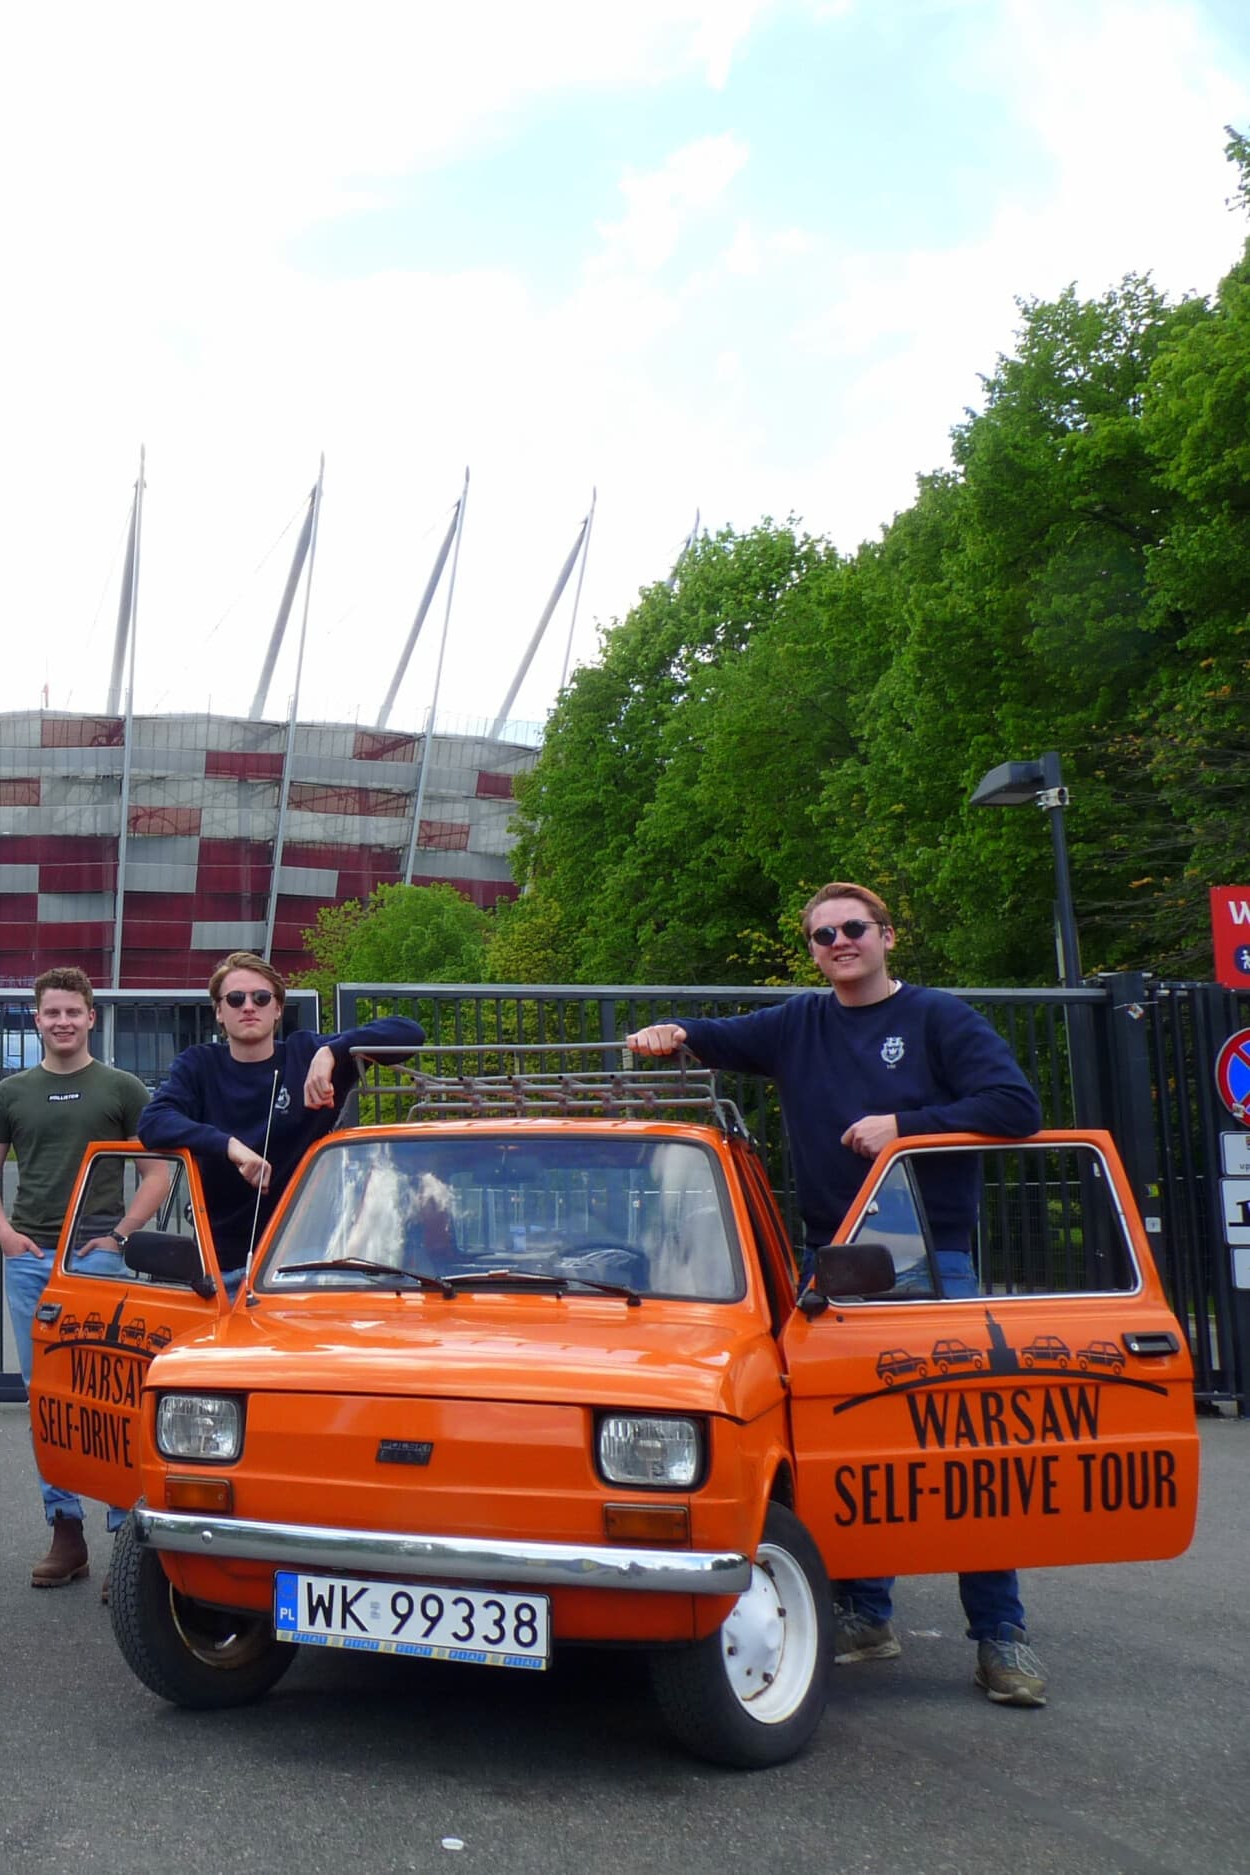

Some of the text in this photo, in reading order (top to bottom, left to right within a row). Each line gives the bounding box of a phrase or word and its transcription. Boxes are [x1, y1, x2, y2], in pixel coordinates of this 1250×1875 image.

[38, 1395, 134, 1469] SELF-DRIVE
[906, 1385, 1100, 1449] WARSAW
[833, 1450, 1177, 1527] SELF-DRIVE TOUR
[279, 1607, 295, 1621] PL
[306, 1581, 539, 1649] WK 99338
